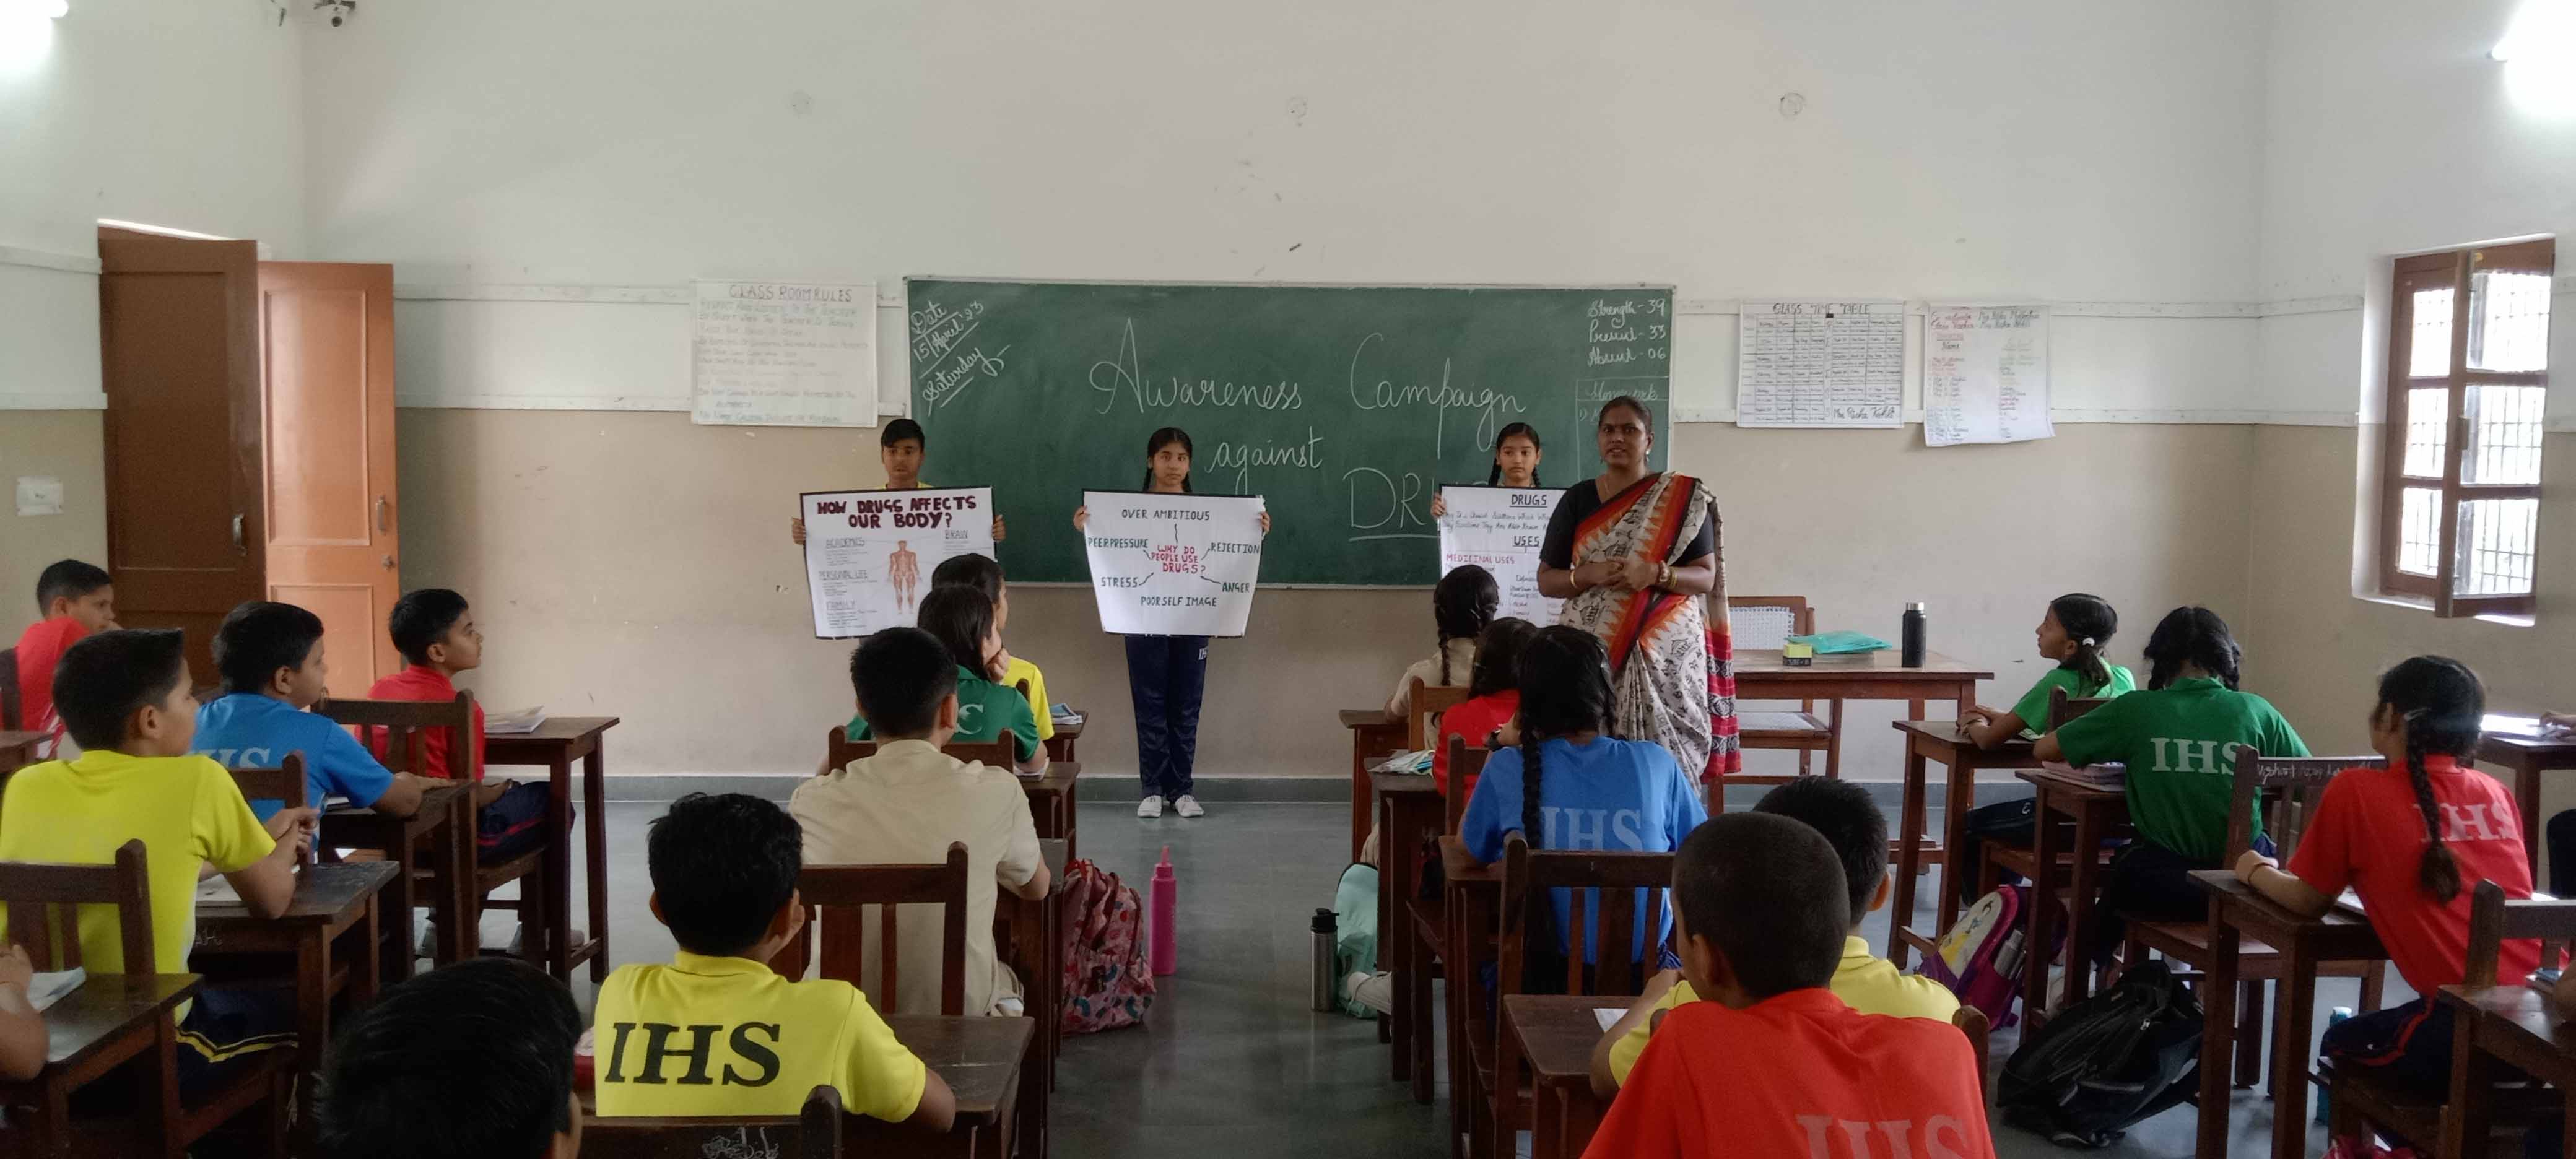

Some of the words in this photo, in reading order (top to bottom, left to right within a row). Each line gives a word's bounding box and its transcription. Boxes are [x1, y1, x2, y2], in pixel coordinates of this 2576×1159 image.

[729, 285, 773, 300] CLASS
[911, 300, 947, 334] Date
[1588, 299, 1637, 328] Strength
[923, 347, 1005, 417] Saturday
[1090, 317, 1302, 414] Awareness
[1351, 332, 1526, 460] Campaign
[1204, 426, 1323, 496] against
[817, 501, 847, 514] HOW
[857, 499, 903, 514] DRUGS
[910, 495, 977, 511] AFFECTS
[1511, 494, 1547, 506] DRUGS
[848, 514, 882, 528] OUR
[894, 512, 952, 528] BODY?
[1121, 509, 1148, 519] OVER
[1154, 510, 1209, 521] AMBITIOUS
[1513, 536, 1540, 547] USES
[1157, 544, 1177, 553] WHY
[1183, 546, 1195, 555] DO
[1211, 542, 1260, 554] REJECTION
[1151, 552, 1179, 562] PEOPLE
[1181, 555, 1199, 564] USE
[1446, 554, 1493, 564] MEDICINAL
[1495, 556, 1515, 565] USES
[1162, 562, 1206, 575] DRUGS?
[1101, 576, 1138, 588] STRESS
[1222, 582, 1250, 593] ANGER
[1185, 597, 1217, 607] IMAGE
[604, 1022, 781, 1087] IHS
